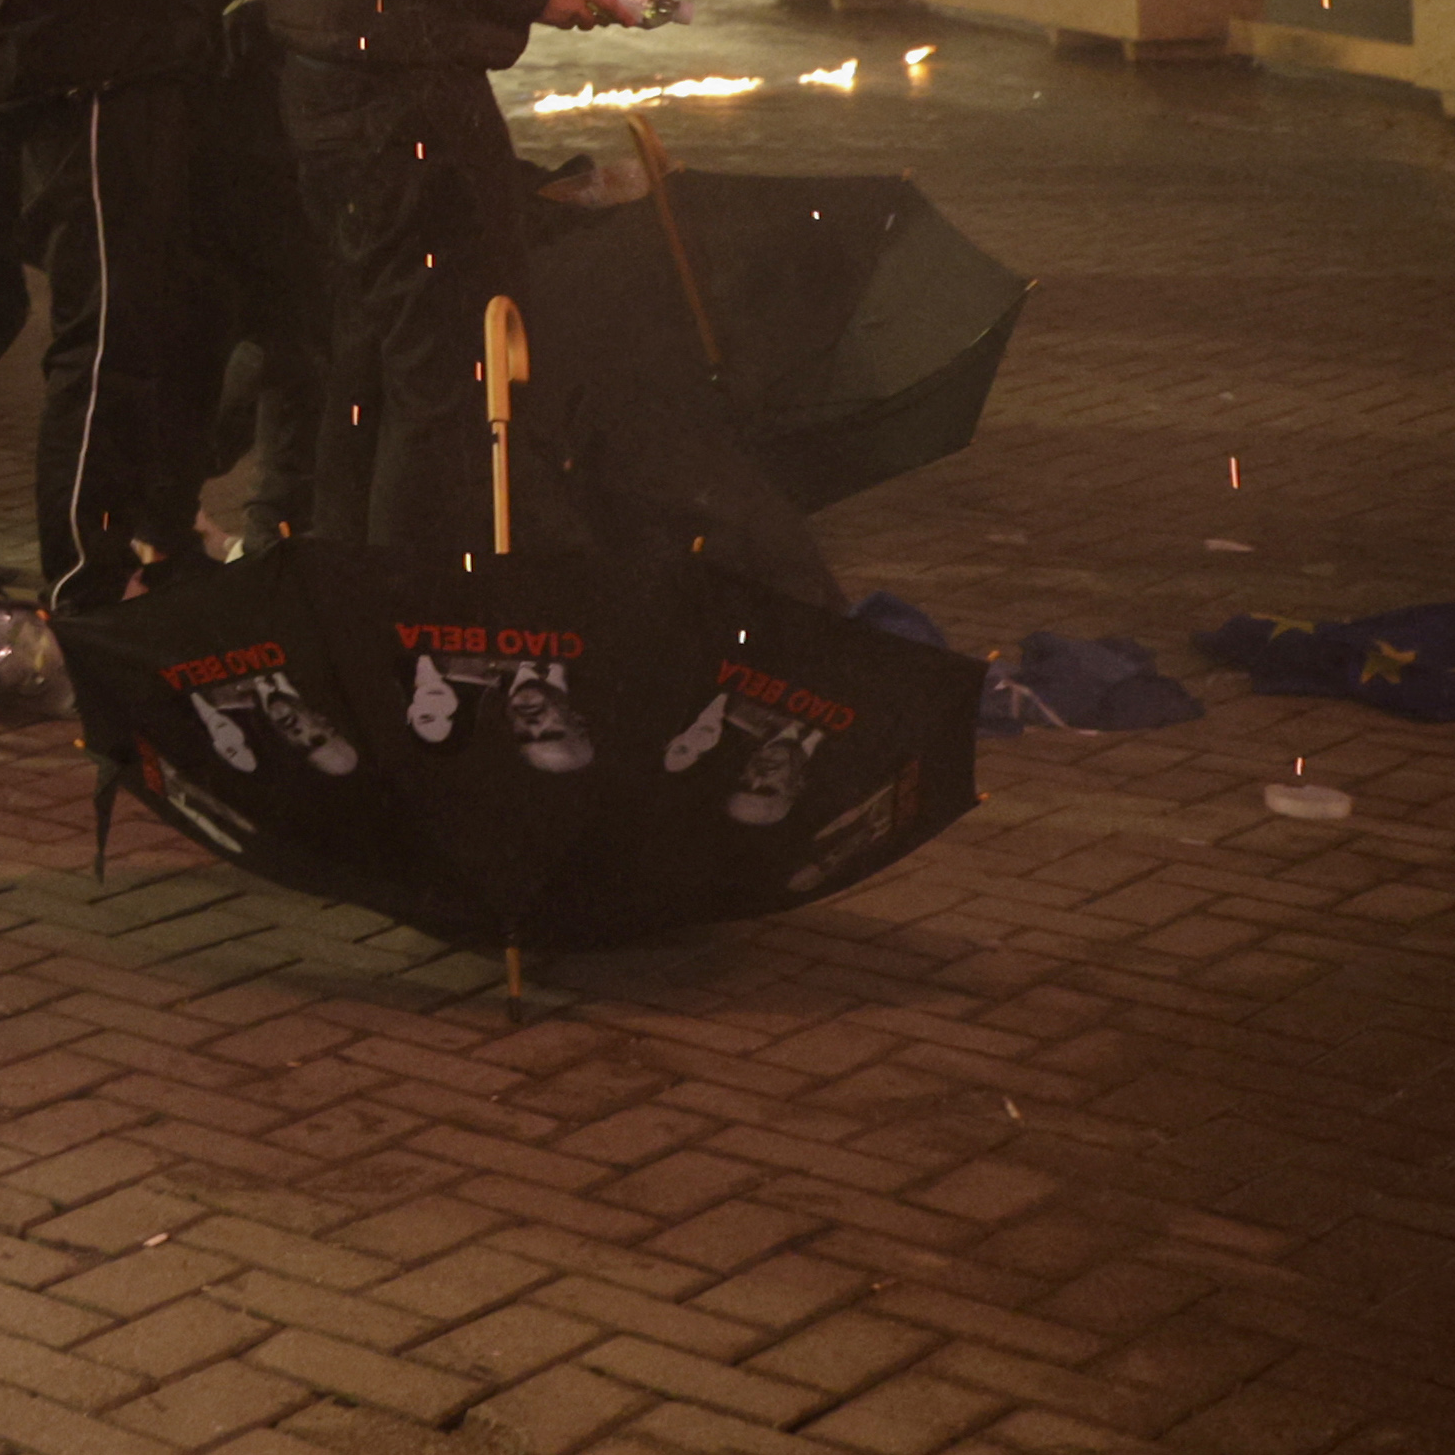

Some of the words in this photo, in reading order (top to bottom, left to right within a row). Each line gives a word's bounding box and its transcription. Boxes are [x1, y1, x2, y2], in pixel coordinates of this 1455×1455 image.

[394, 622, 489, 654] BELA
[495, 627, 585, 659] CIAO
[158, 654, 230, 690] BELA
[224, 641, 286, 675] CIAO
[715, 659, 789, 705] BELA
[786, 688, 856, 731] CIAO
